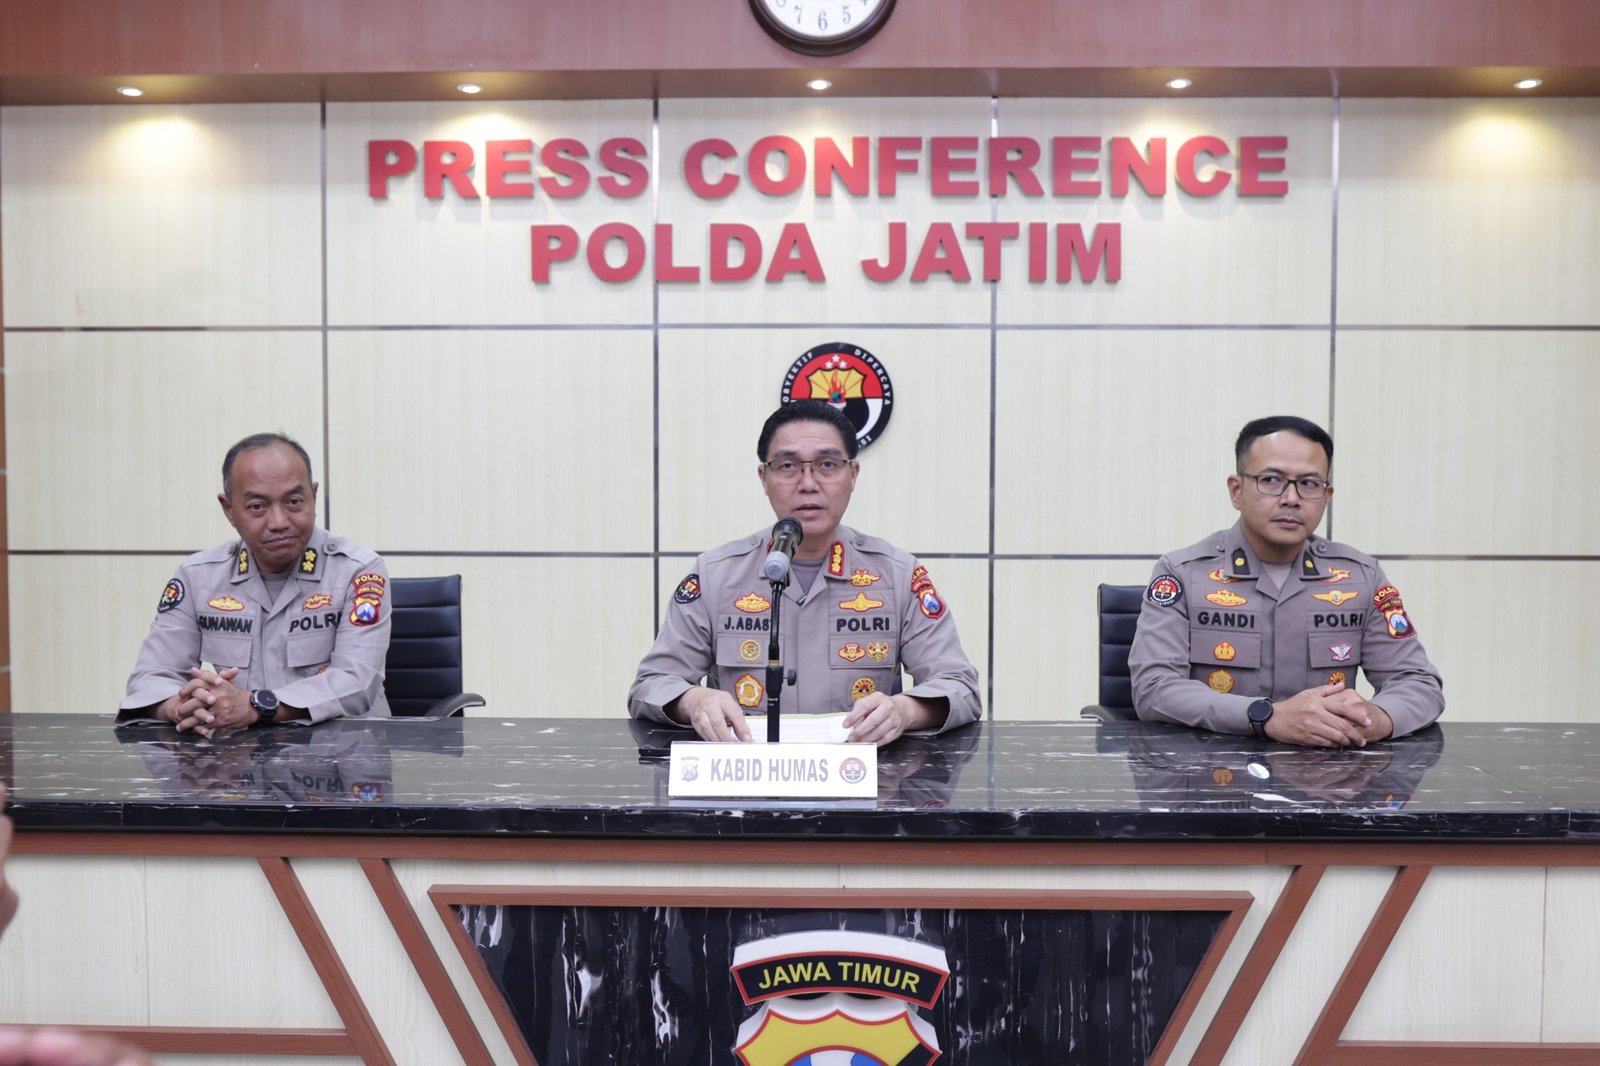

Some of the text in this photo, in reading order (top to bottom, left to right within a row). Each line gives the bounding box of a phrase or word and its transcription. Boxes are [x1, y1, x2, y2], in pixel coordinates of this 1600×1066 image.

[794, 5, 803, 24] 7
[817, 10, 828, 31] 6
[842, 5, 851, 24] 5
[368, 135, 1289, 199] PRESS CONFERENCE
[531, 222, 1122, 284] POLDA JATIM
[783, 349, 891, 405] OBYEKTIF DIPERCAYA
[289, 611, 342, 633] POLRI
[724, 616, 772, 632] J.ABAS
[836, 617, 890, 632] POLRI
[1197, 612, 1255, 628] GANDI
[1314, 613, 1364, 628] POLRI
[710, 758, 829, 782] KABID HUMAS
[758, 961, 921, 994] JAWA TIMUR
